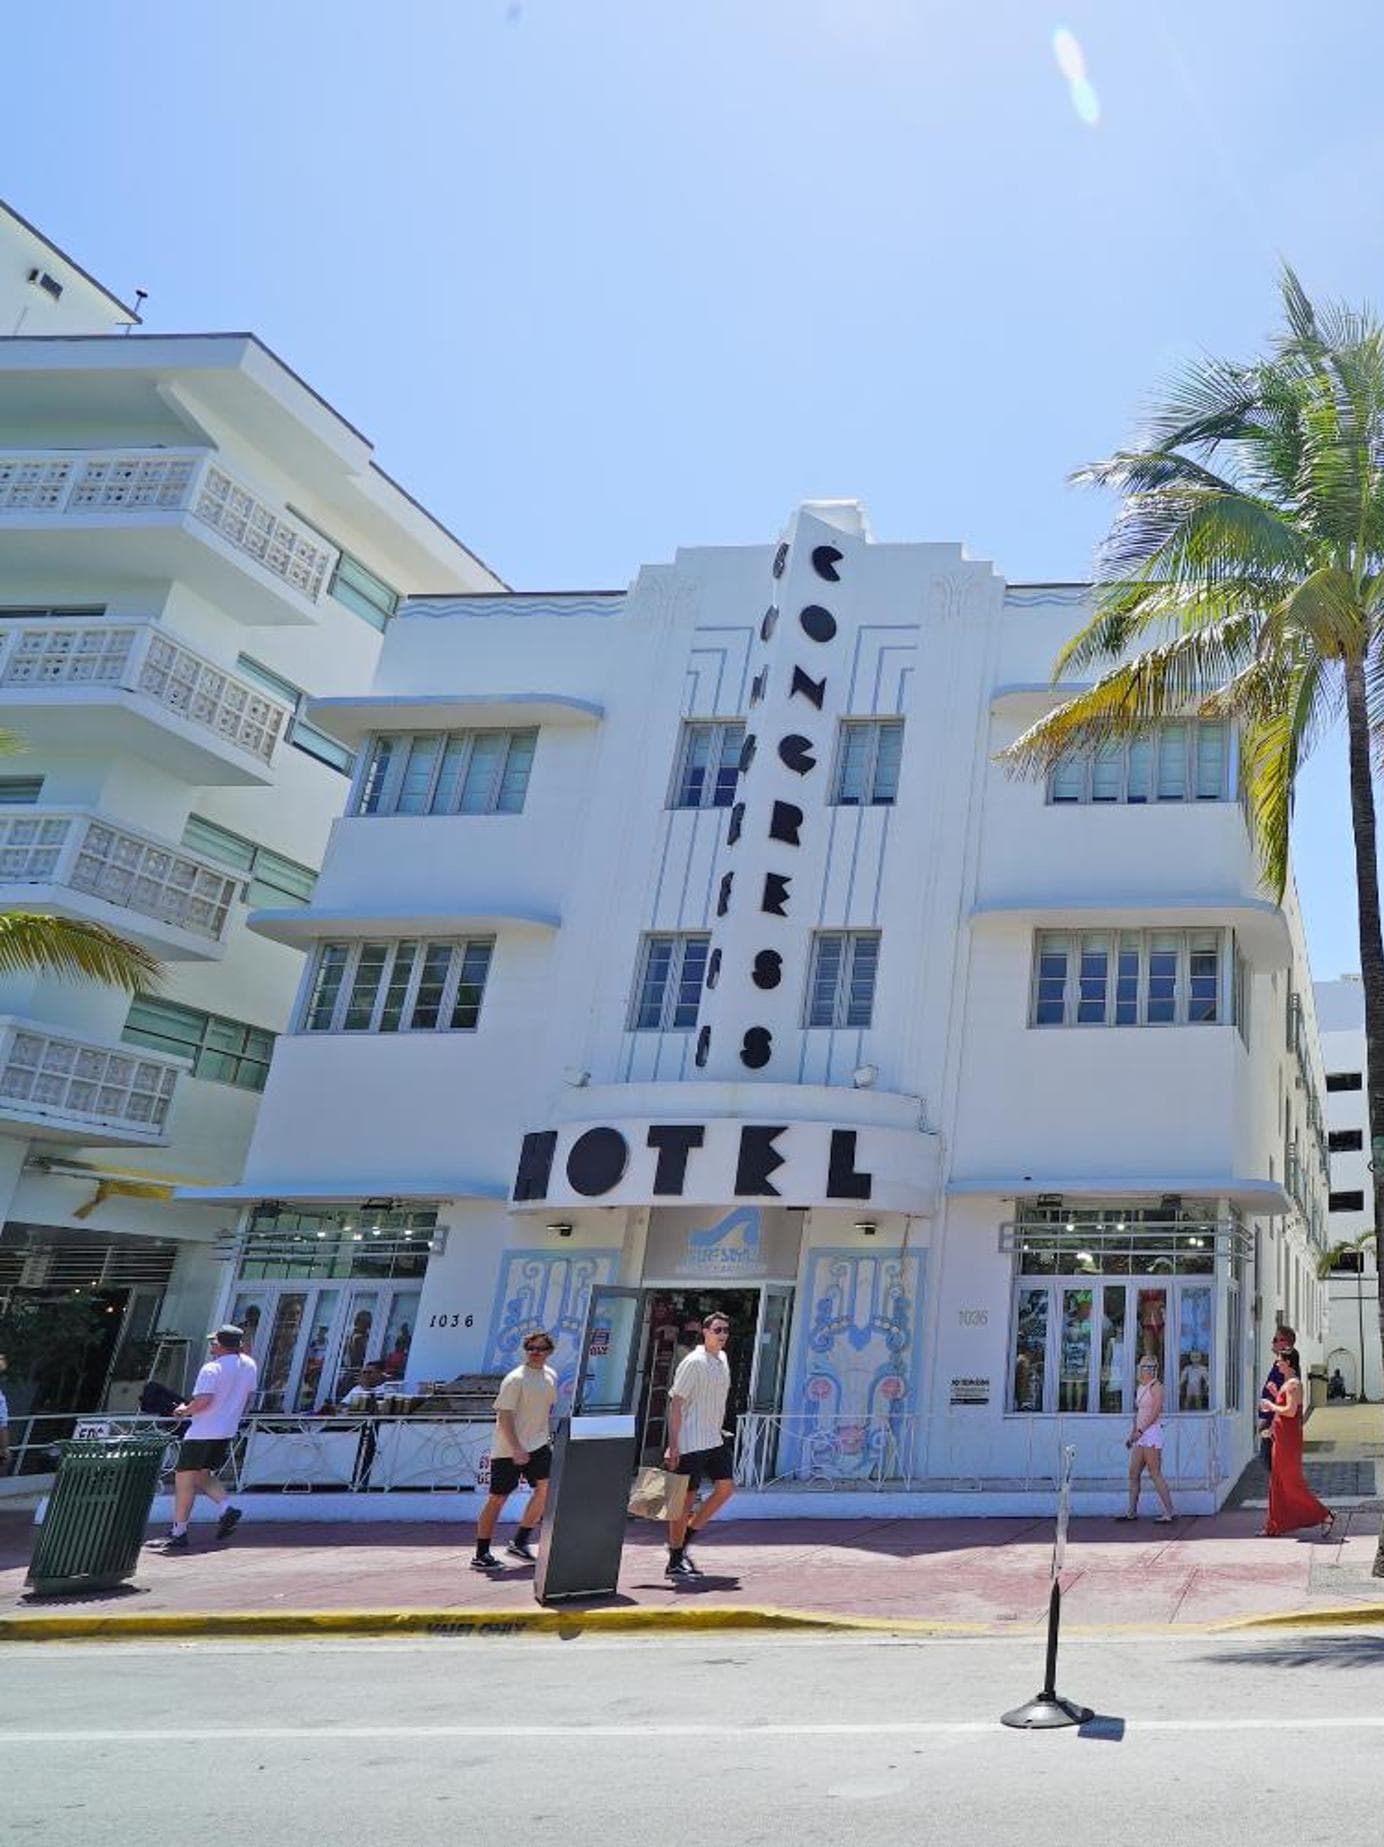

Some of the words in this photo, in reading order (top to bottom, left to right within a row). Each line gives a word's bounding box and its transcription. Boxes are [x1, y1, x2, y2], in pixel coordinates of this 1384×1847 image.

[740, 544, 844, 1069] CONGRESS
[512, 1125, 872, 1201] HOTEL
[430, 1313, 474, 1328] 1036
[958, 1309, 989, 1327] 1036
